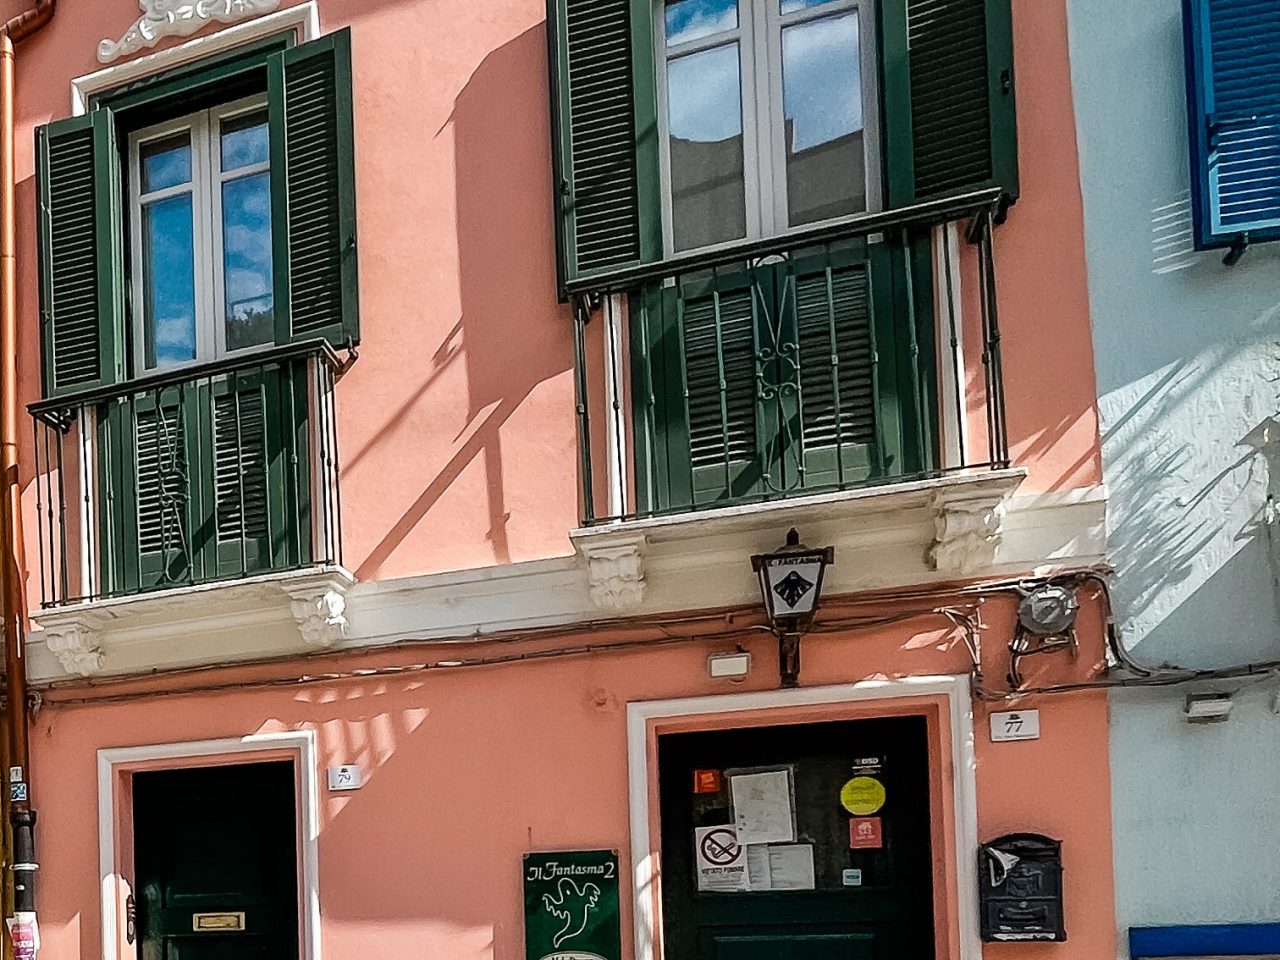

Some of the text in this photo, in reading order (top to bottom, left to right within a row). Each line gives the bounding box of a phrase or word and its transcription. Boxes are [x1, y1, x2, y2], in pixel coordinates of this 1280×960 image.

[1005, 719, 1024, 733] 77
[338, 774, 351, 784] 79
[542, 862, 605, 880] Fantasma
[603, 861, 615, 878] 2
